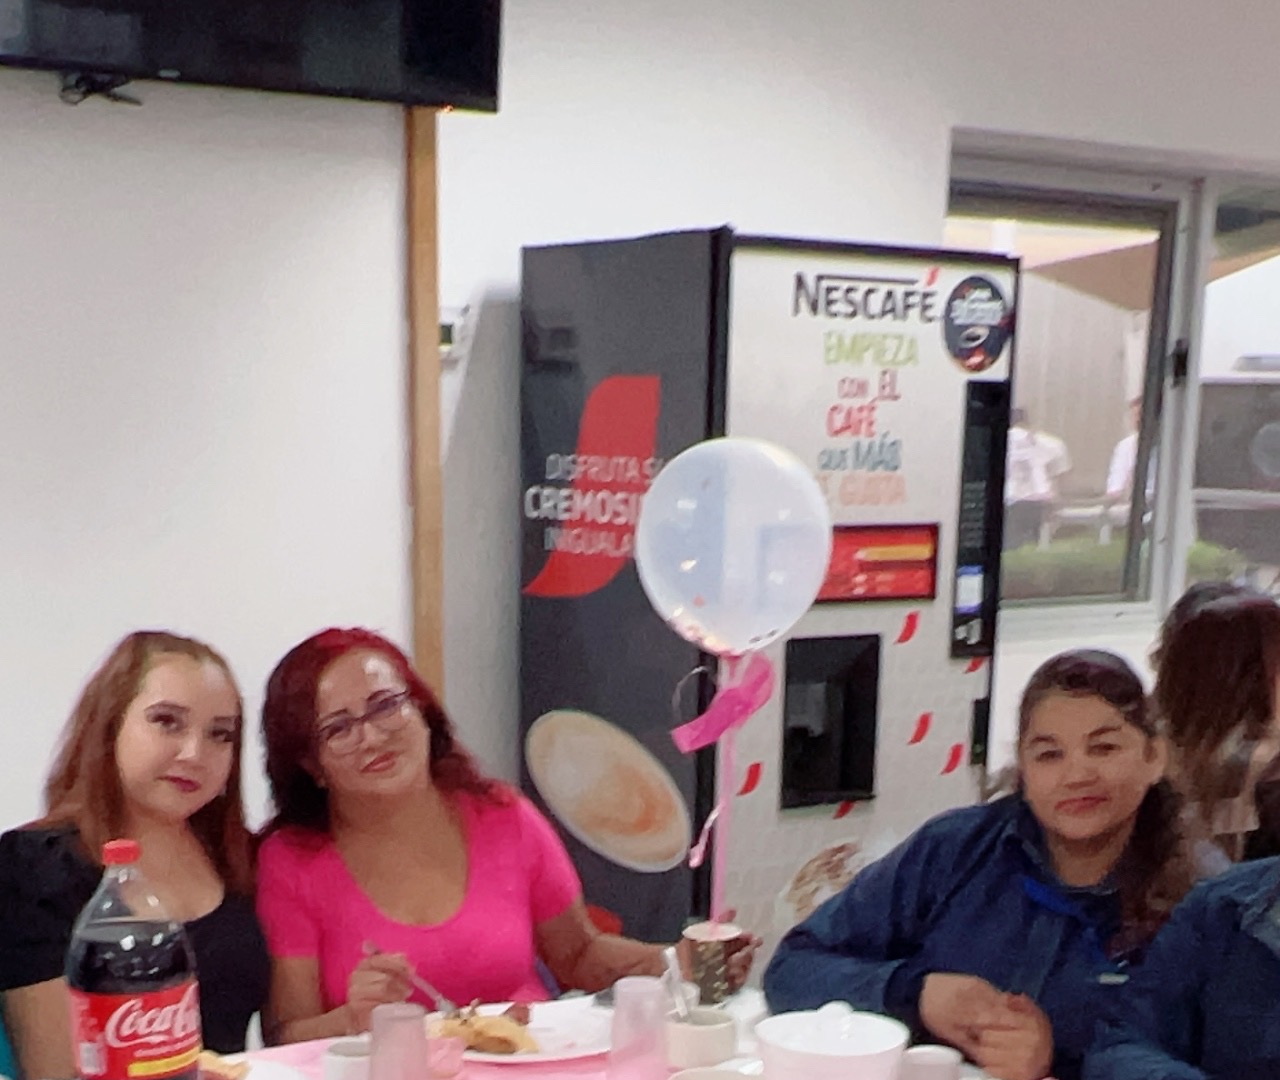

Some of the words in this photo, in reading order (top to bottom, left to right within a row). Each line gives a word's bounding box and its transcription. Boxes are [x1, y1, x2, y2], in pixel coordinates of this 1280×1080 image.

[793, 266, 940, 323] NESCAFÉ
[823, 330, 919, 367] EMPIEZA
[524, 486, 638, 525] CREMOSI
